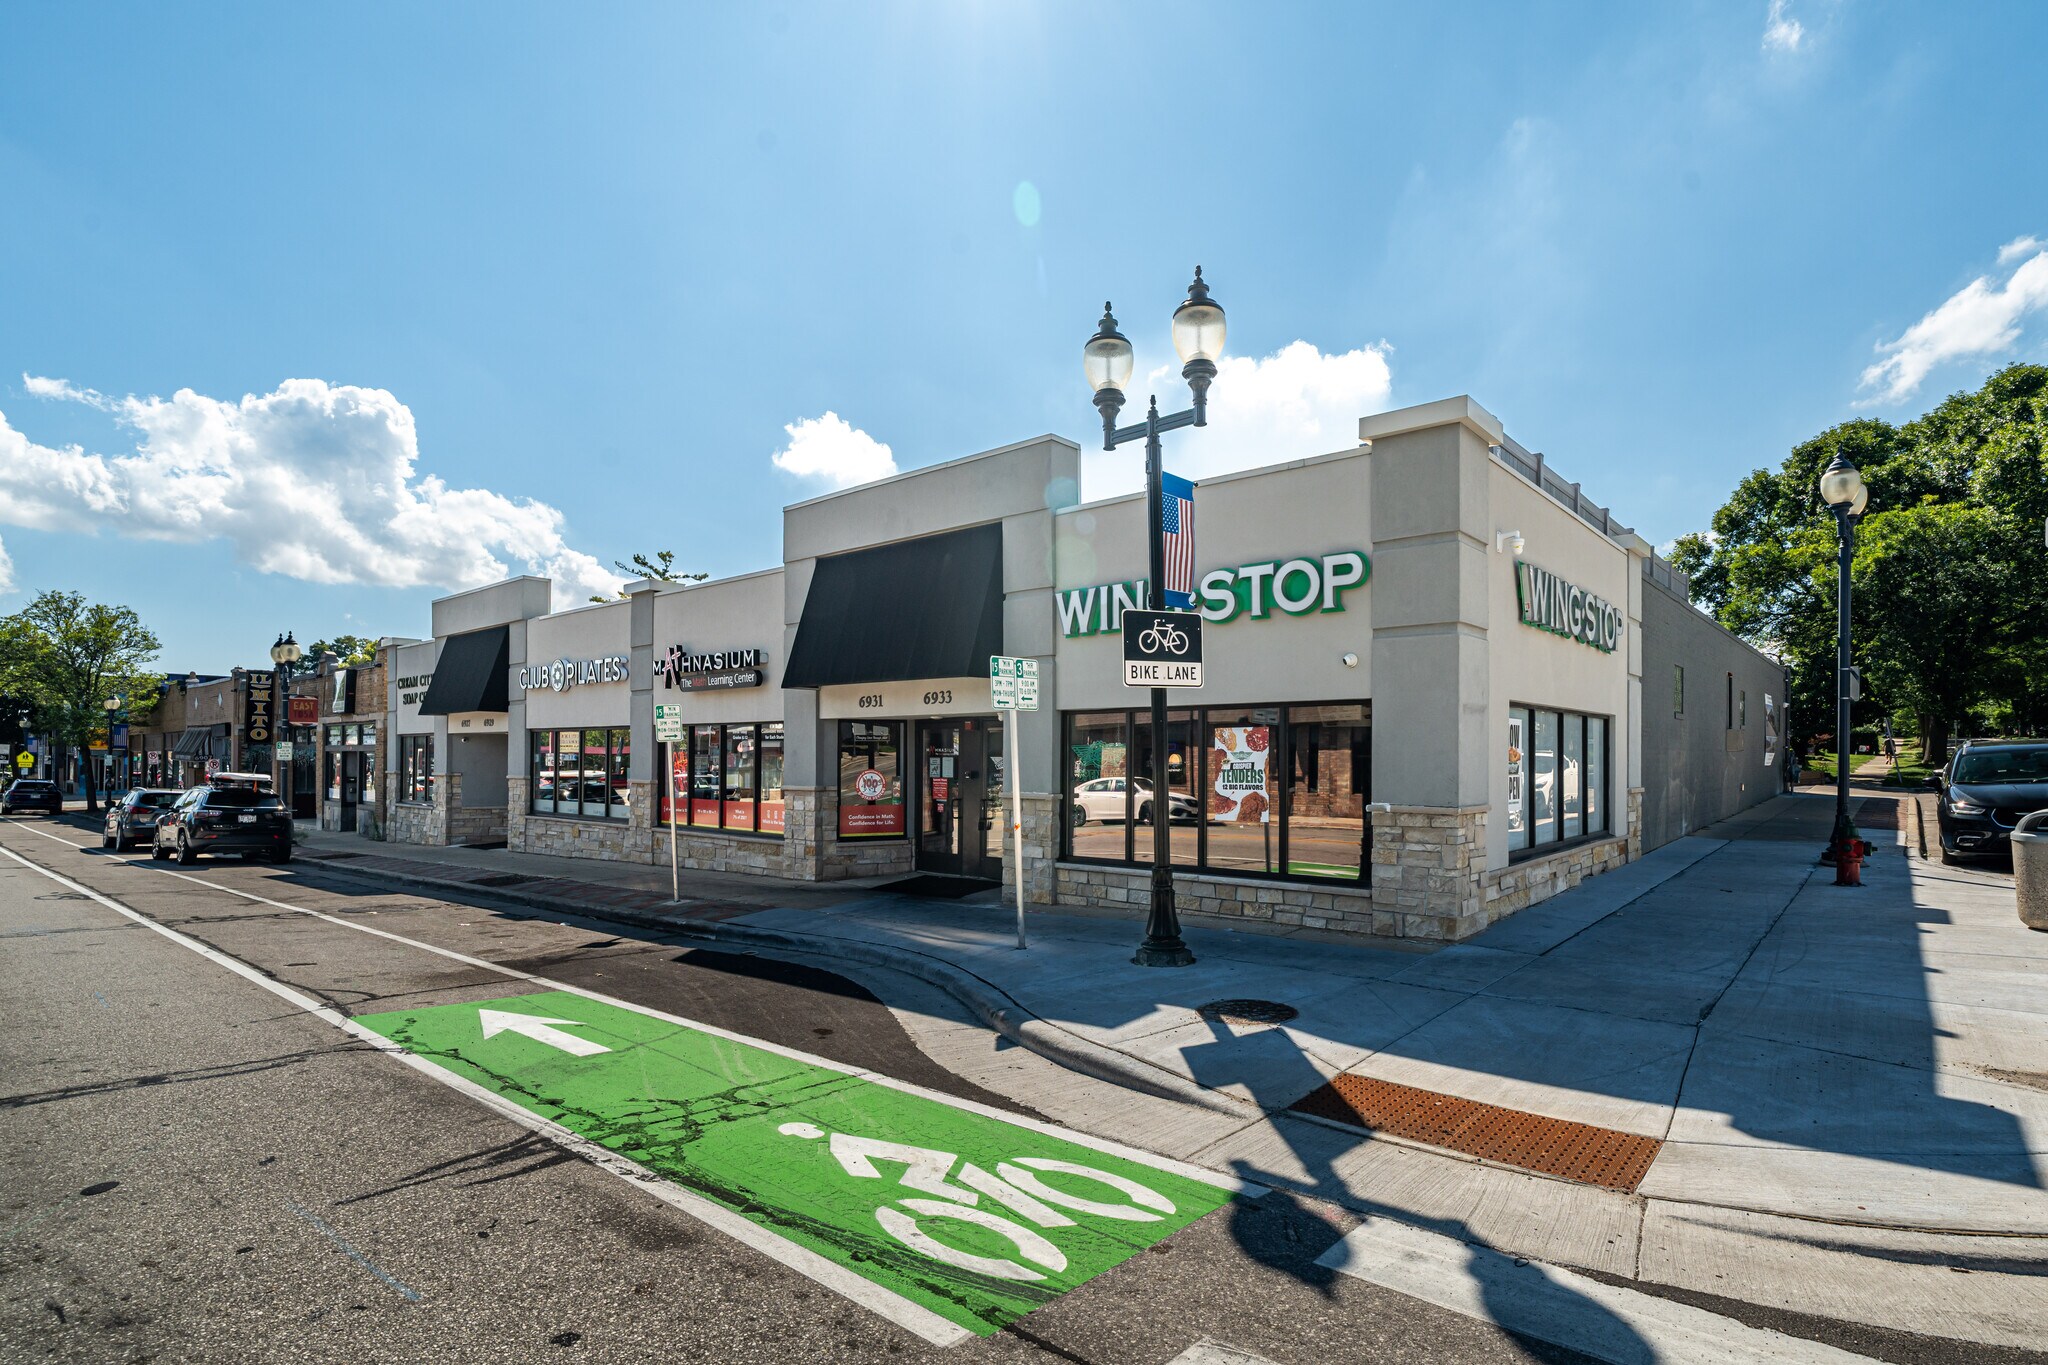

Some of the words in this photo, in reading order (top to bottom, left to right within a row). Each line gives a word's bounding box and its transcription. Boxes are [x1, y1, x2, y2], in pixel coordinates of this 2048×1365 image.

[1054, 552, 1367, 636] WINSTOP
[519, 665, 550, 690] CLUB
[566, 656, 624, 686] PILATES
[991, 662, 999, 672] 15
[1017, 663, 1023, 676] 3
[1130, 665, 1159, 680] BIKE
[1167, 665, 1198, 681] LANE
[250, 674, 272, 685] IL
[397, 675, 419, 689] CREAM
[681, 678, 692, 688] The
[707, 674, 734, 687] Learning
[734, 672, 755, 684] Center
[402, 692, 418, 705] SOAP
[859, 694, 883, 708] 6931
[923, 689, 953, 705] 6933
[293, 701, 315, 711] EAST
[1509, 724, 1520, 749] OW
[1222, 769, 1264, 783] TENDERS
[1509, 776, 1520, 800] PEN
